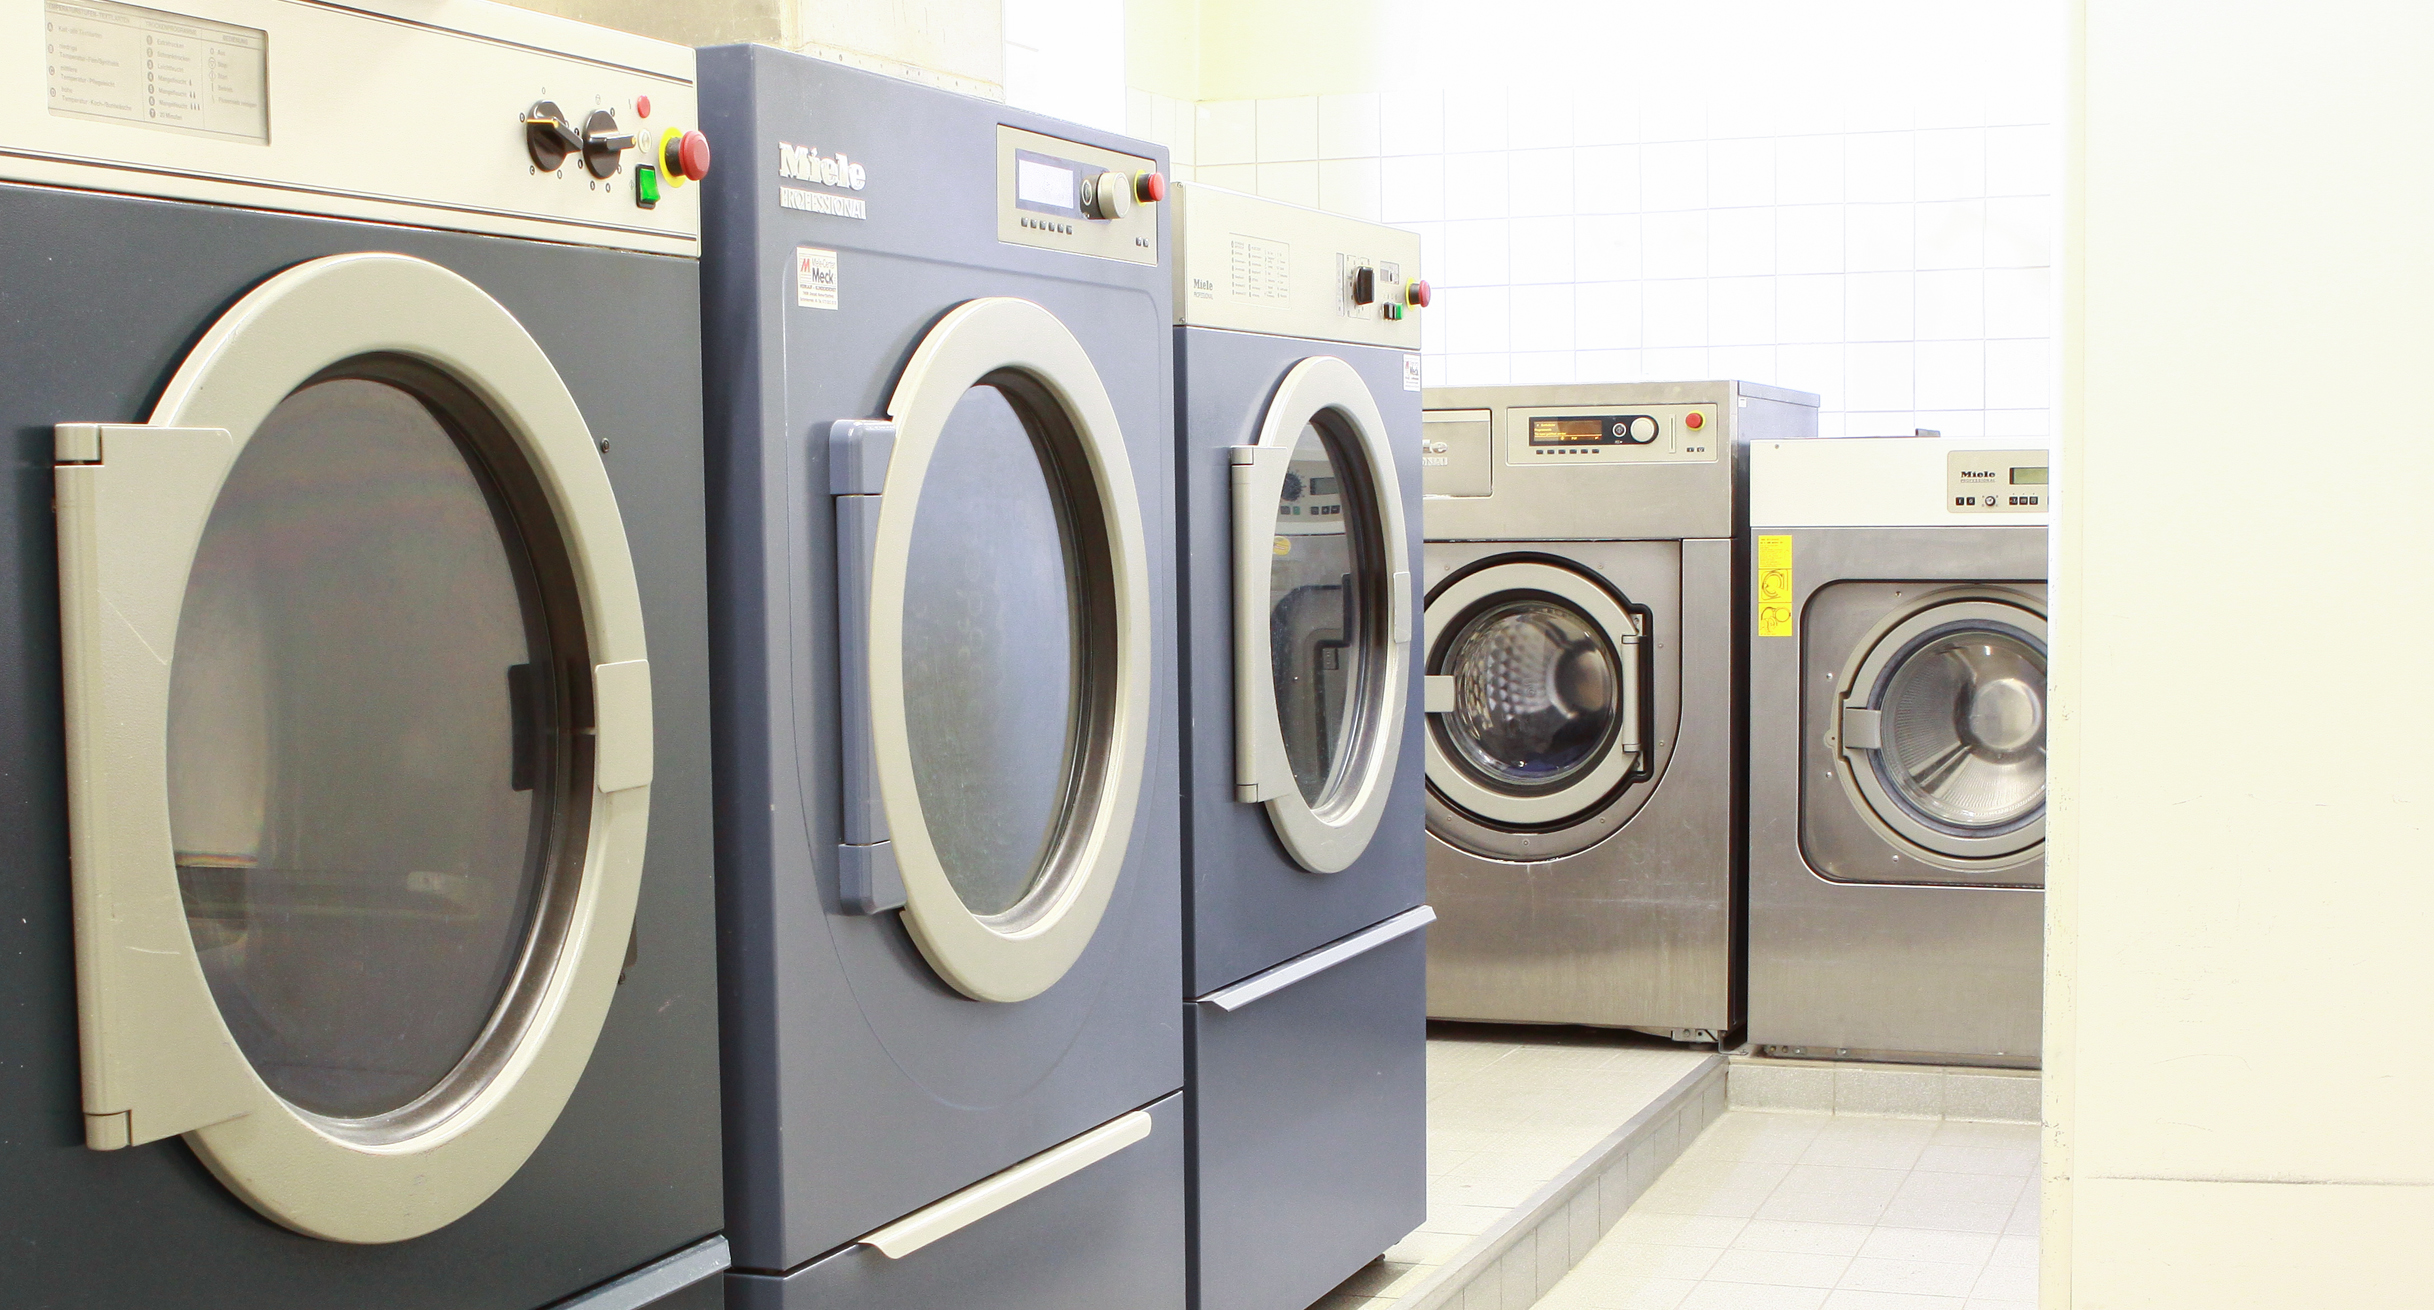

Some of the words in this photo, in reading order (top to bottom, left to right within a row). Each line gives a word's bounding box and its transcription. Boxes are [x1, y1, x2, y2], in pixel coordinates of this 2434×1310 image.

[778, 141, 867, 192] Miele
[780, 187, 867, 220] PROFESSIONAL
[812, 267, 834, 284] Meck
[1193, 278, 1214, 291] Miele
